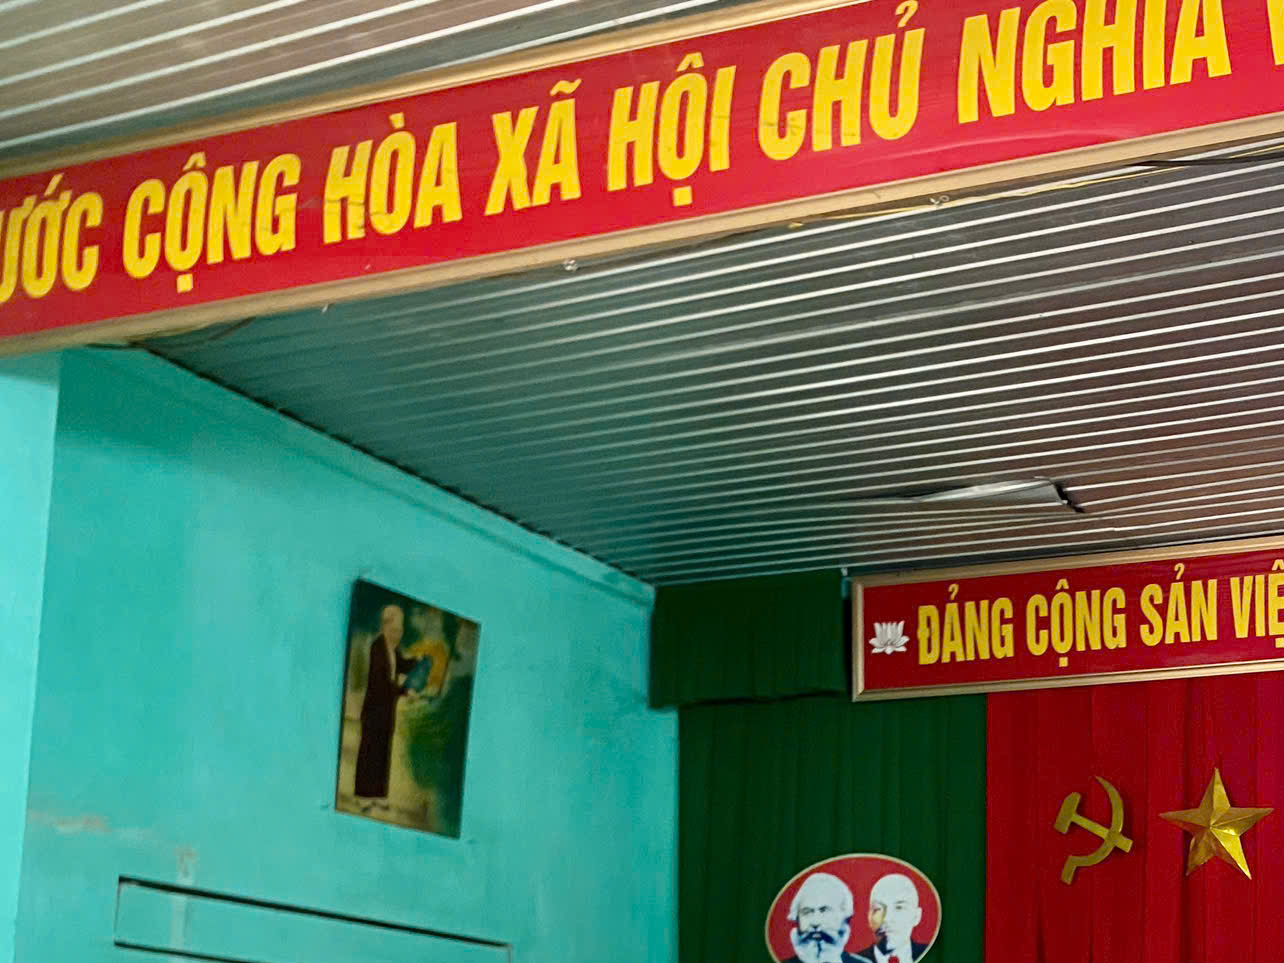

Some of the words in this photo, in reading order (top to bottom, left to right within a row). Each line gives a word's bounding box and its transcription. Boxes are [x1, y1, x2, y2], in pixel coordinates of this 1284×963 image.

[123, 151, 301, 293] CỘNG
[323, 112, 463, 244] HÒA
[484, 78, 582, 216] XÃ
[607, 51, 737, 206] HỘI
[757, 0, 926, 161] CHỦ
[917, 583, 1015, 665] ĐẢNG
[1026, 578, 1127, 668] CỘNG
[1140, 563, 1218, 648] SẢN
